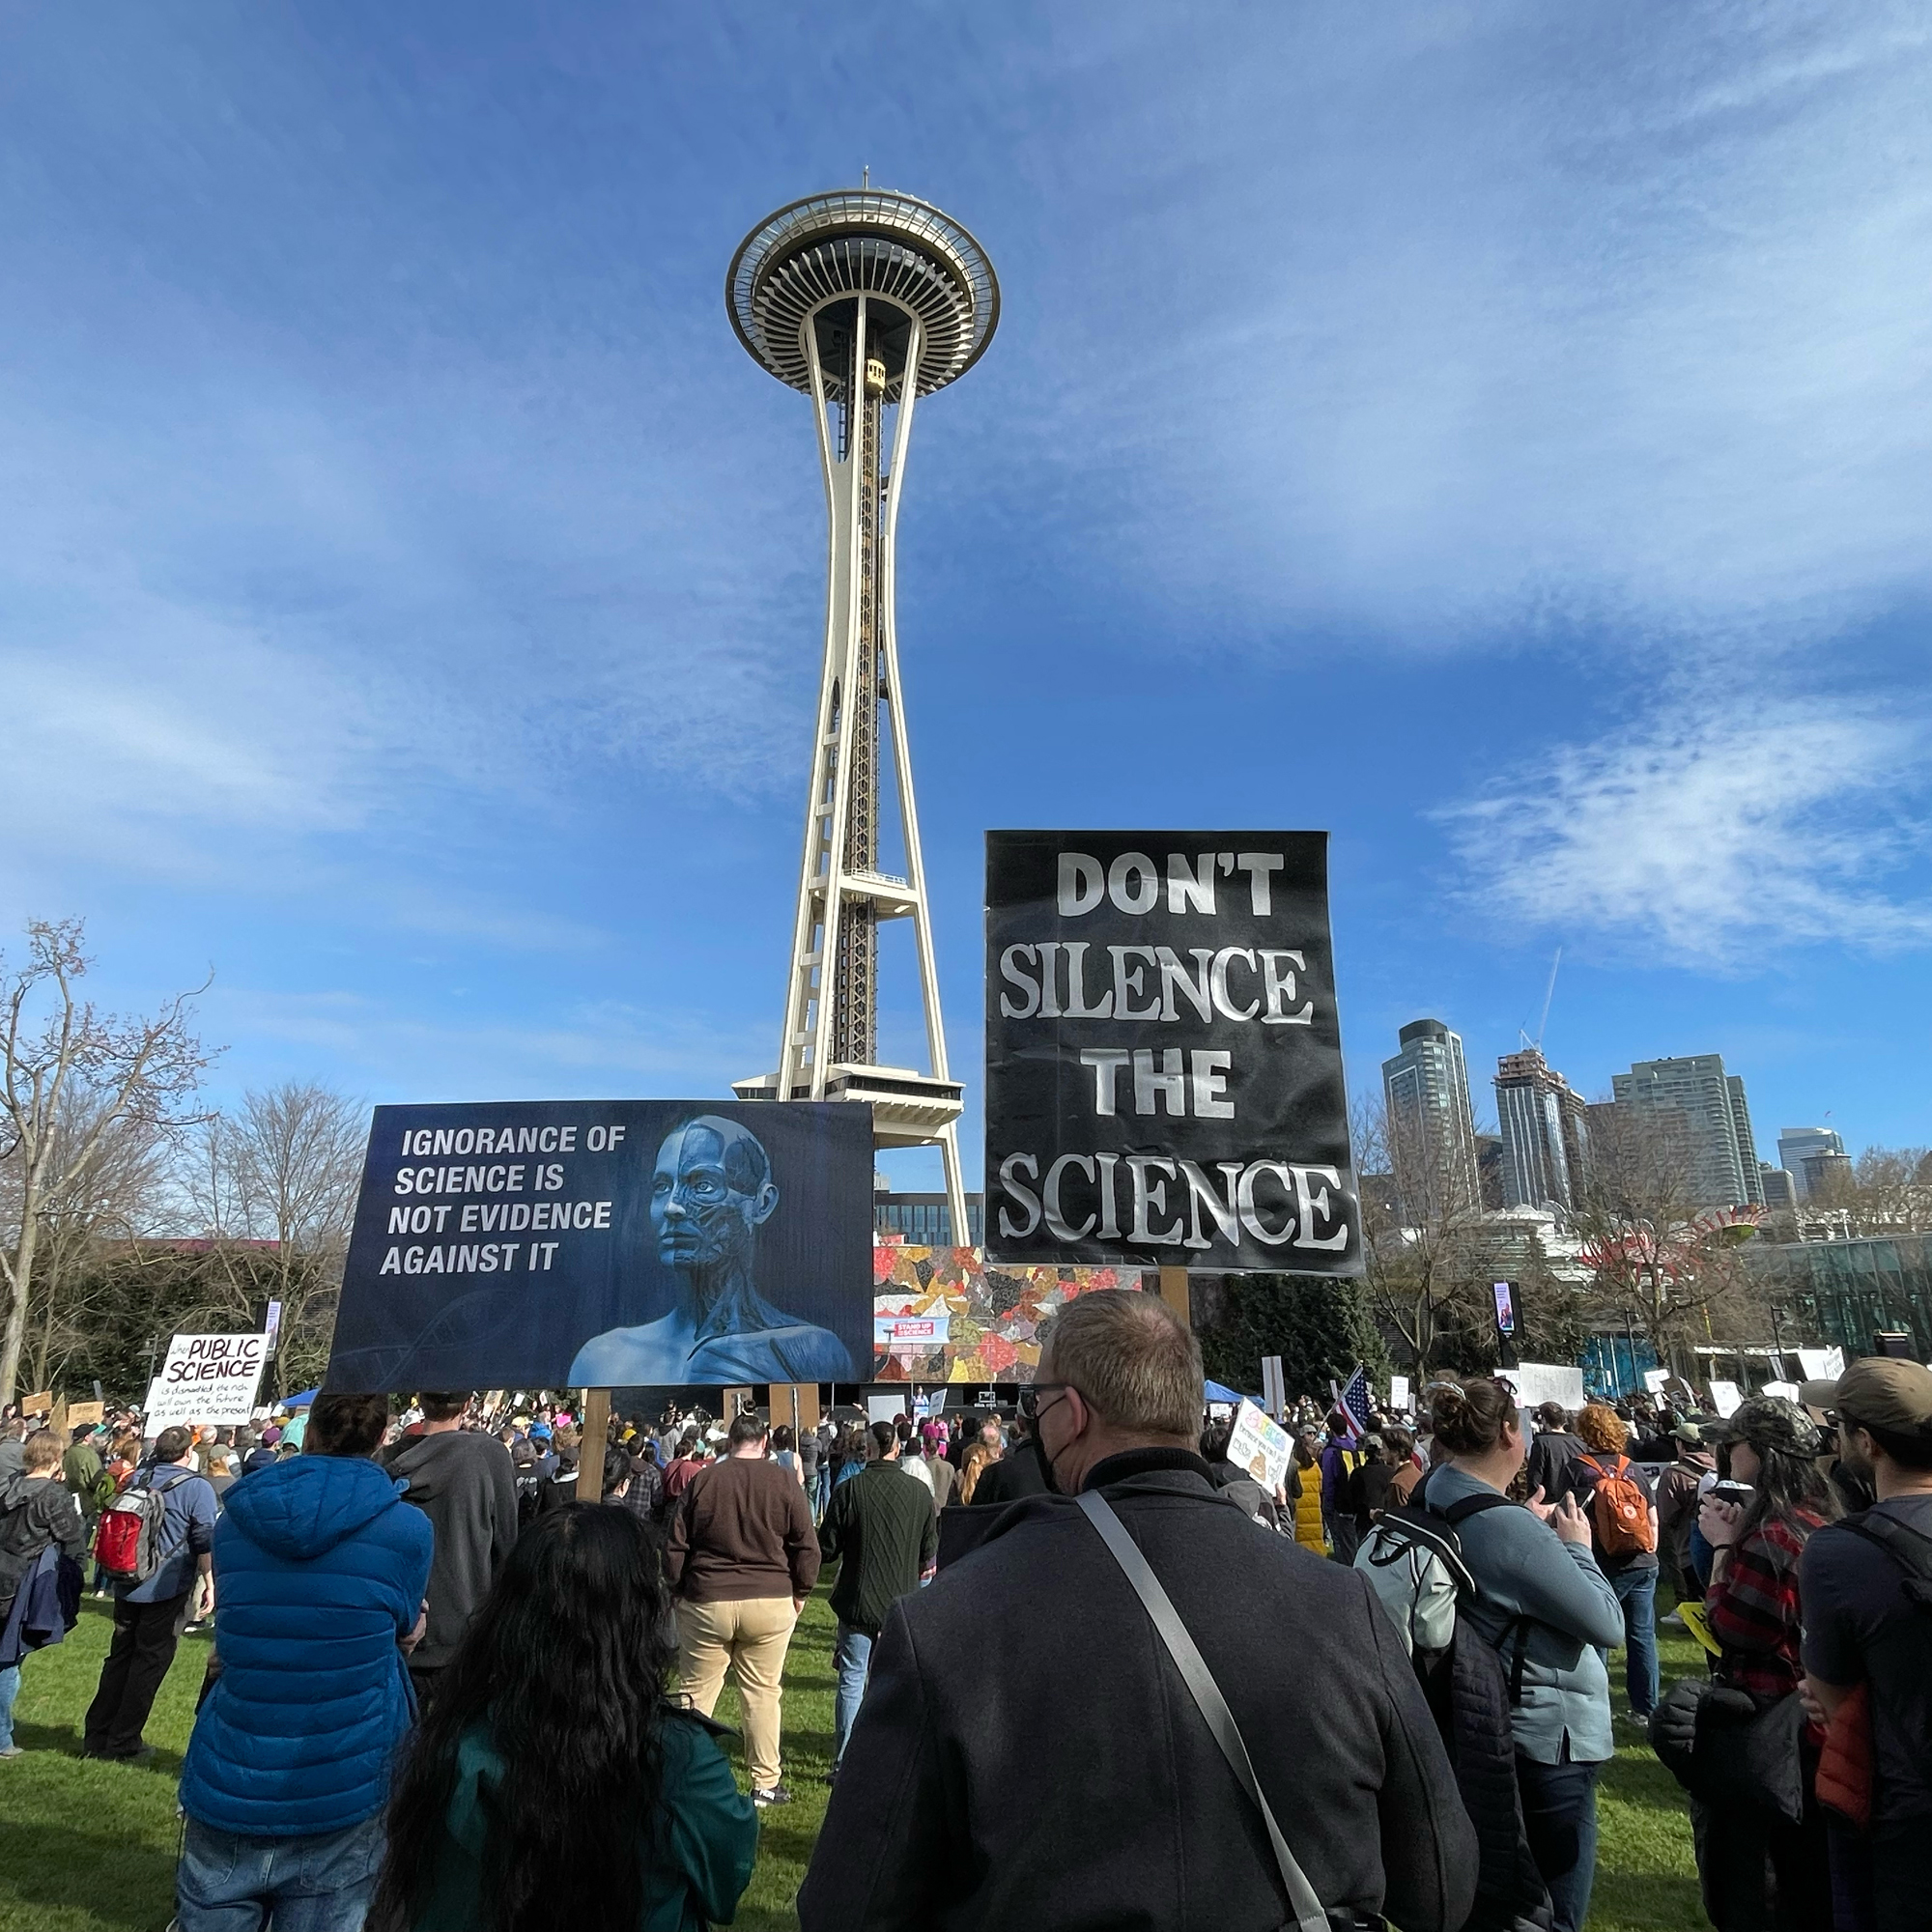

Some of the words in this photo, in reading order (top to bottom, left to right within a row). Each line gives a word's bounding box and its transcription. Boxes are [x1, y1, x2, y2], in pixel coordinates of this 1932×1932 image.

[1057, 851, 1285, 918] DON'T
[999, 941, 1314, 1026] SILENCE
[1079, 1047, 1236, 1121] THE
[401, 1124, 579, 1157] IGNORANCE
[585, 1124, 627, 1152] OF
[393, 1164, 525, 1196] SCIENCE
[533, 1163, 565, 1191] IS
[998, 1151, 1349, 1252] SCIENCE
[387, 1205, 454, 1236] NOT
[459, 1201, 612, 1234] EVIDENCE
[379, 1242, 520, 1276] AGAINST
[527, 1241, 560, 1272] IT
[188, 1339, 259, 1360] PUBLIC
[167, 1360, 261, 1383] SCIENCE
[156, 1396, 173, 1406] will
[196, 1395, 211, 1405] the
[160, 1386, 170, 1396] is
[169, 1406, 186, 1416] well
[206, 1405, 220, 1414] the
[220, 1402, 251, 1418] present
